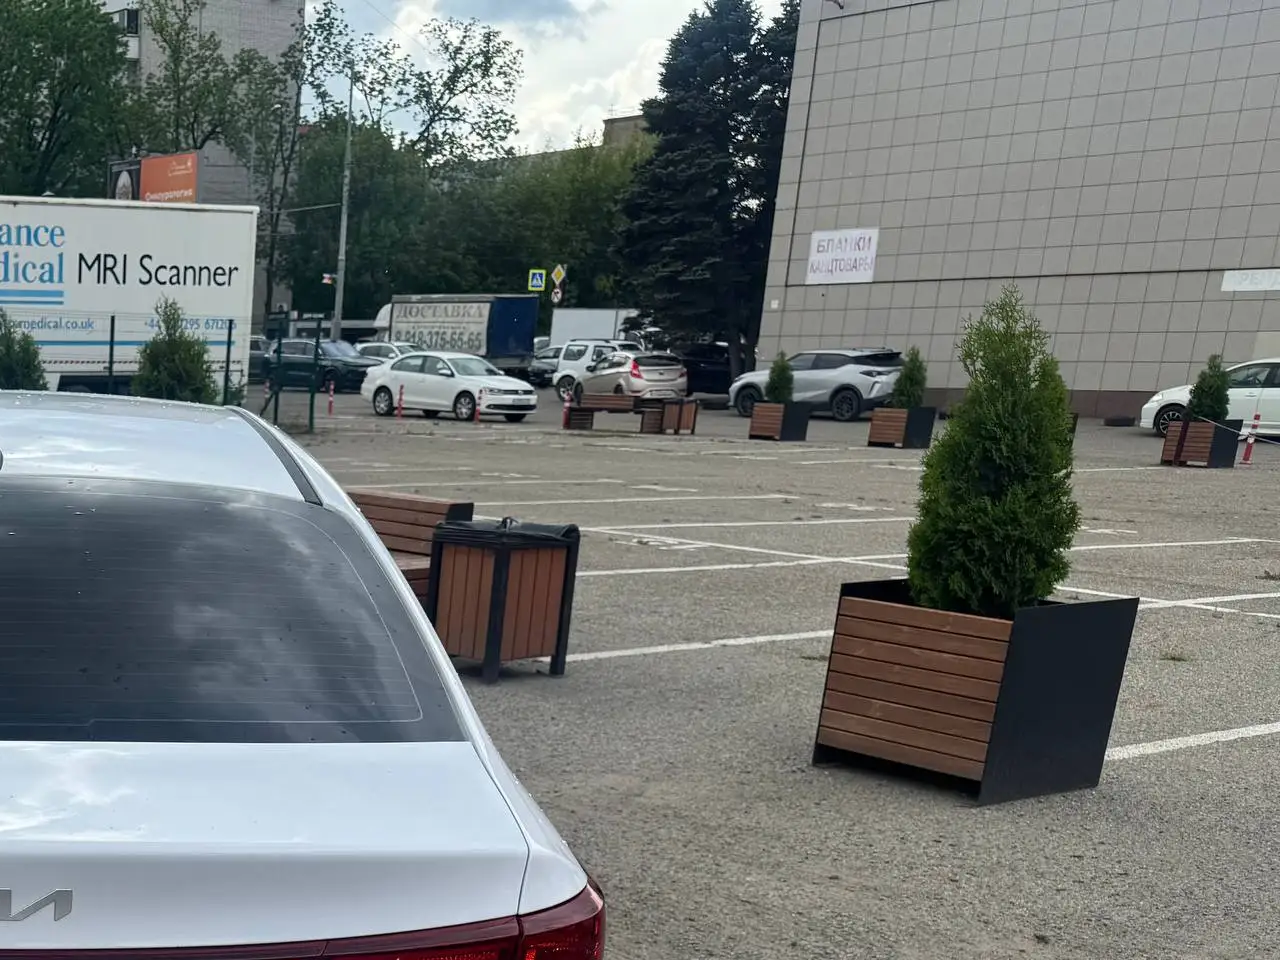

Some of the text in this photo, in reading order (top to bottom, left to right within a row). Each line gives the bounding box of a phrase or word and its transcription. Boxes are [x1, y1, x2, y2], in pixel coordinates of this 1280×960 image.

[77, 252, 240, 288] MRI Scanner
[396, 303, 487, 319] ДОСТАВКА
